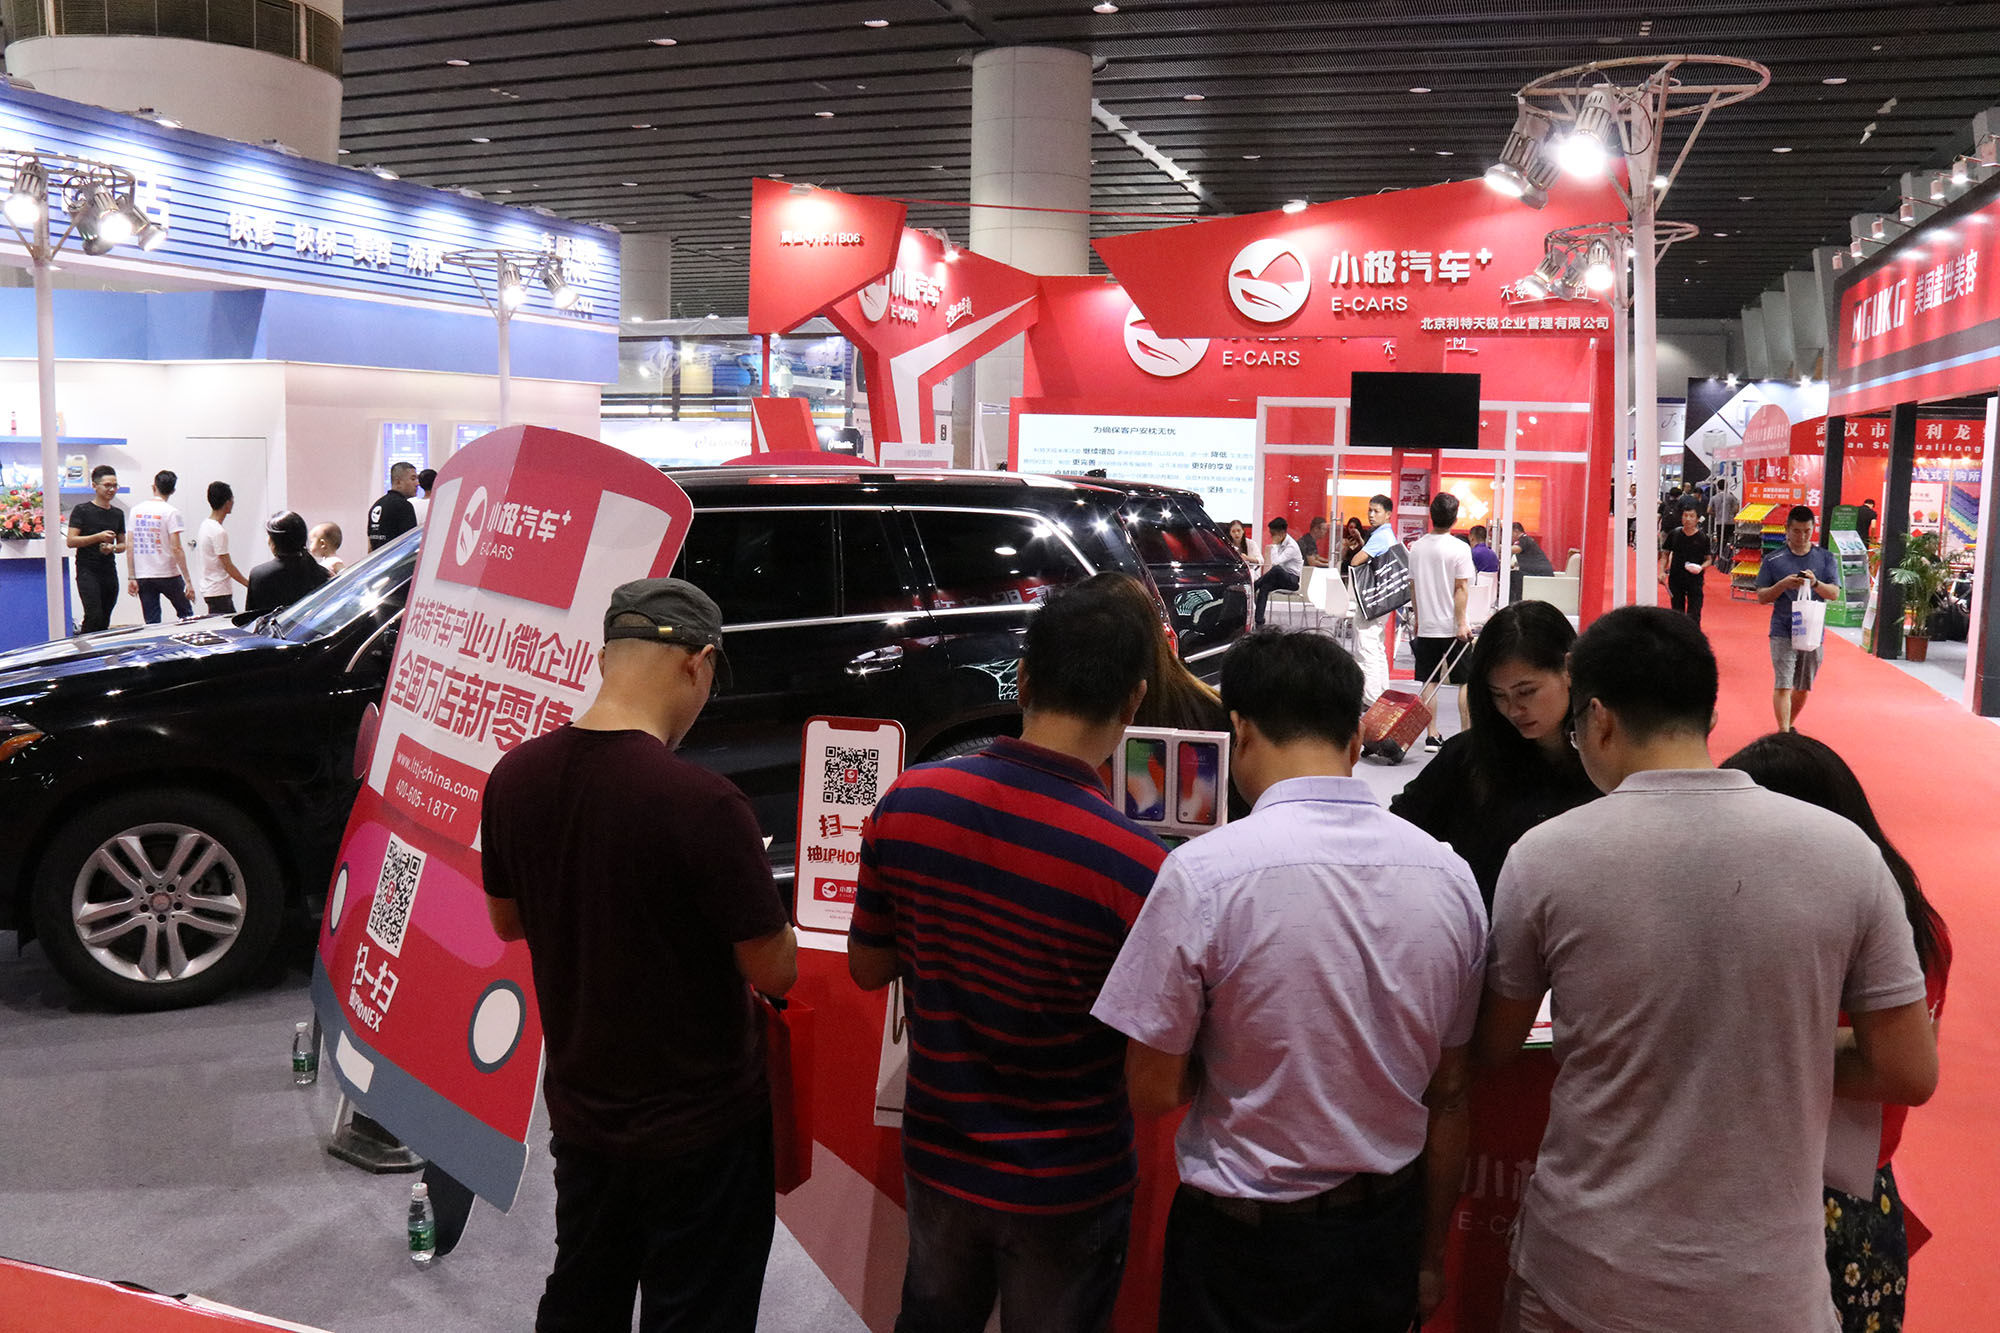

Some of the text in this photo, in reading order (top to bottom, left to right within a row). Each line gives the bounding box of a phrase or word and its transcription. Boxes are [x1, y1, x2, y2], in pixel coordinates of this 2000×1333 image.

[891, 304, 919, 323] E-CARS
[1331, 296, 1409, 312] E-CARS
[1420, 316, 1610, 331] 北京利特天极企业管理有限公司
[1222, 350, 1301, 367] E-CARS
[406, 595, 595, 693] 扶持汽车产业小微企业
[395, 778, 458, 824] 400-605-1877
[352, 942, 400, 1014] 扫一扫
